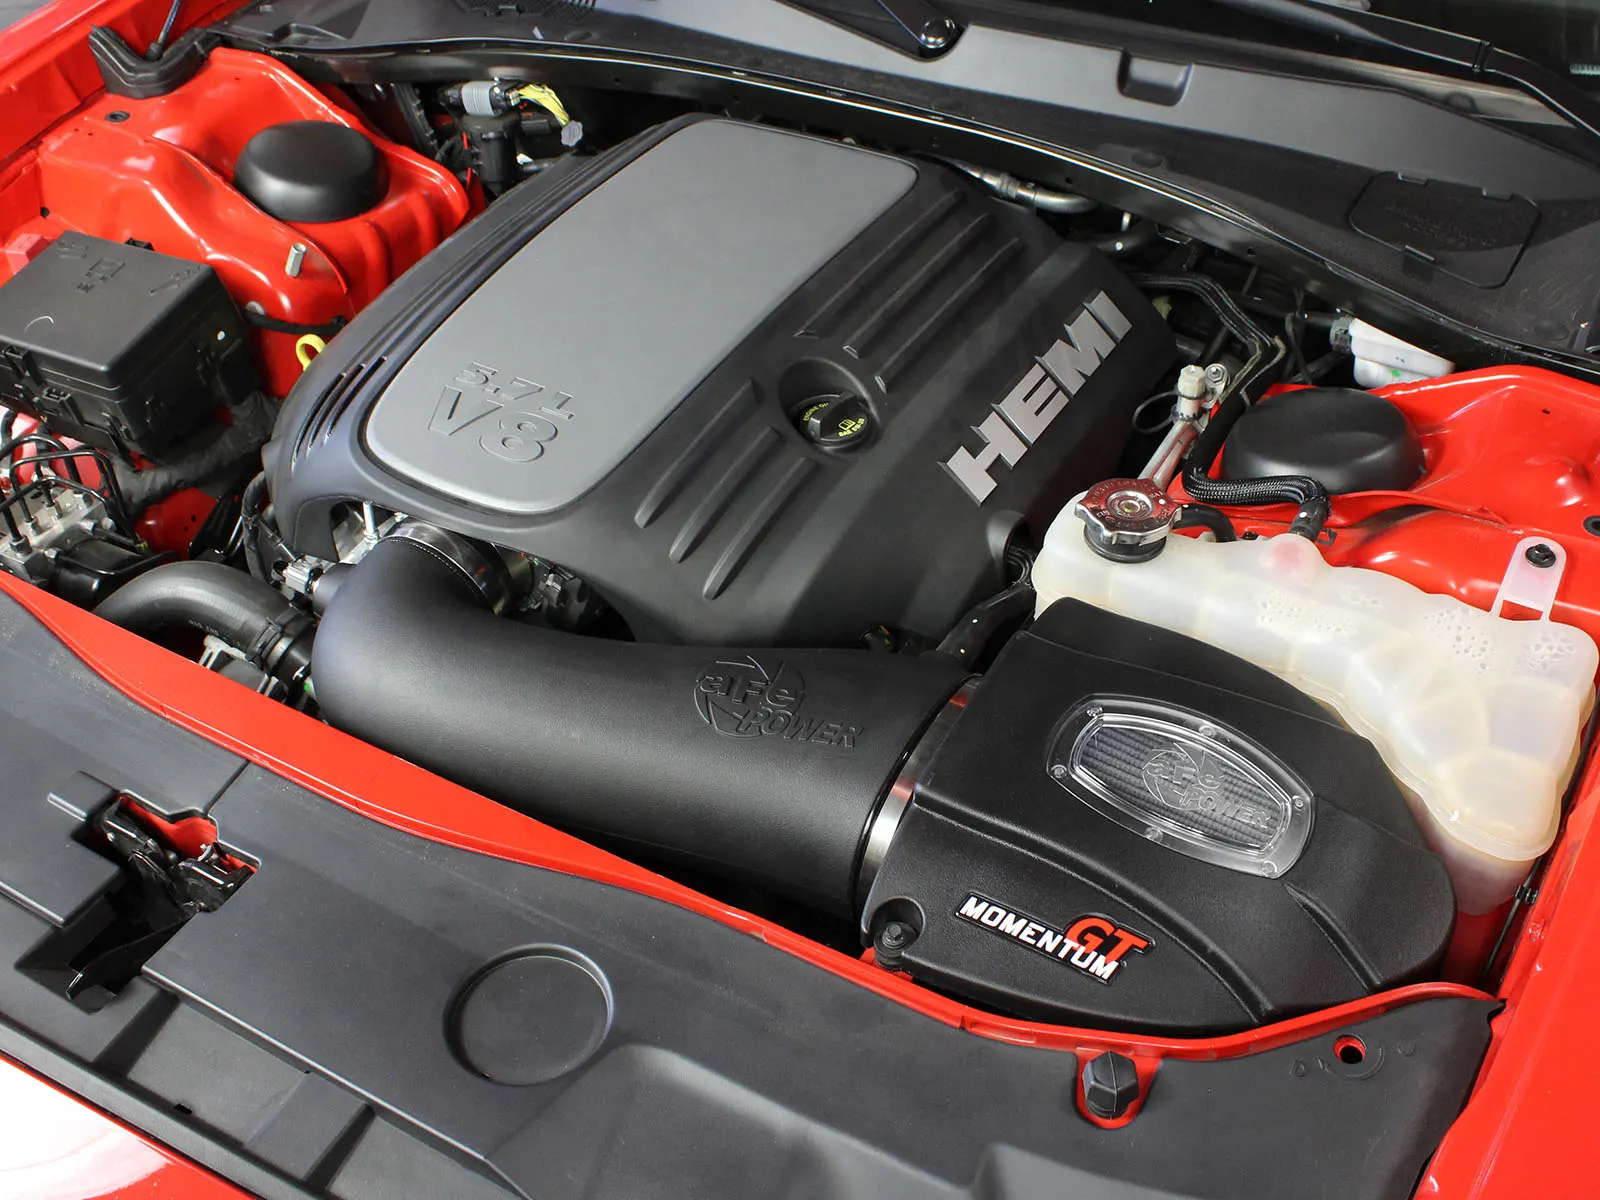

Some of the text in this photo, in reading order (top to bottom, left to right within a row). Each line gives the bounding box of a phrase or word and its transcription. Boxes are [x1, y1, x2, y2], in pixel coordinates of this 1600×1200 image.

[428, 385, 558, 463] V8
[937, 290, 1133, 507] HEMI
[733, 706, 864, 749] POWER
[1174, 785, 1273, 830] POWER
[959, 896, 1120, 980] MOMENTUM
[1063, 917, 1149, 965] GT
